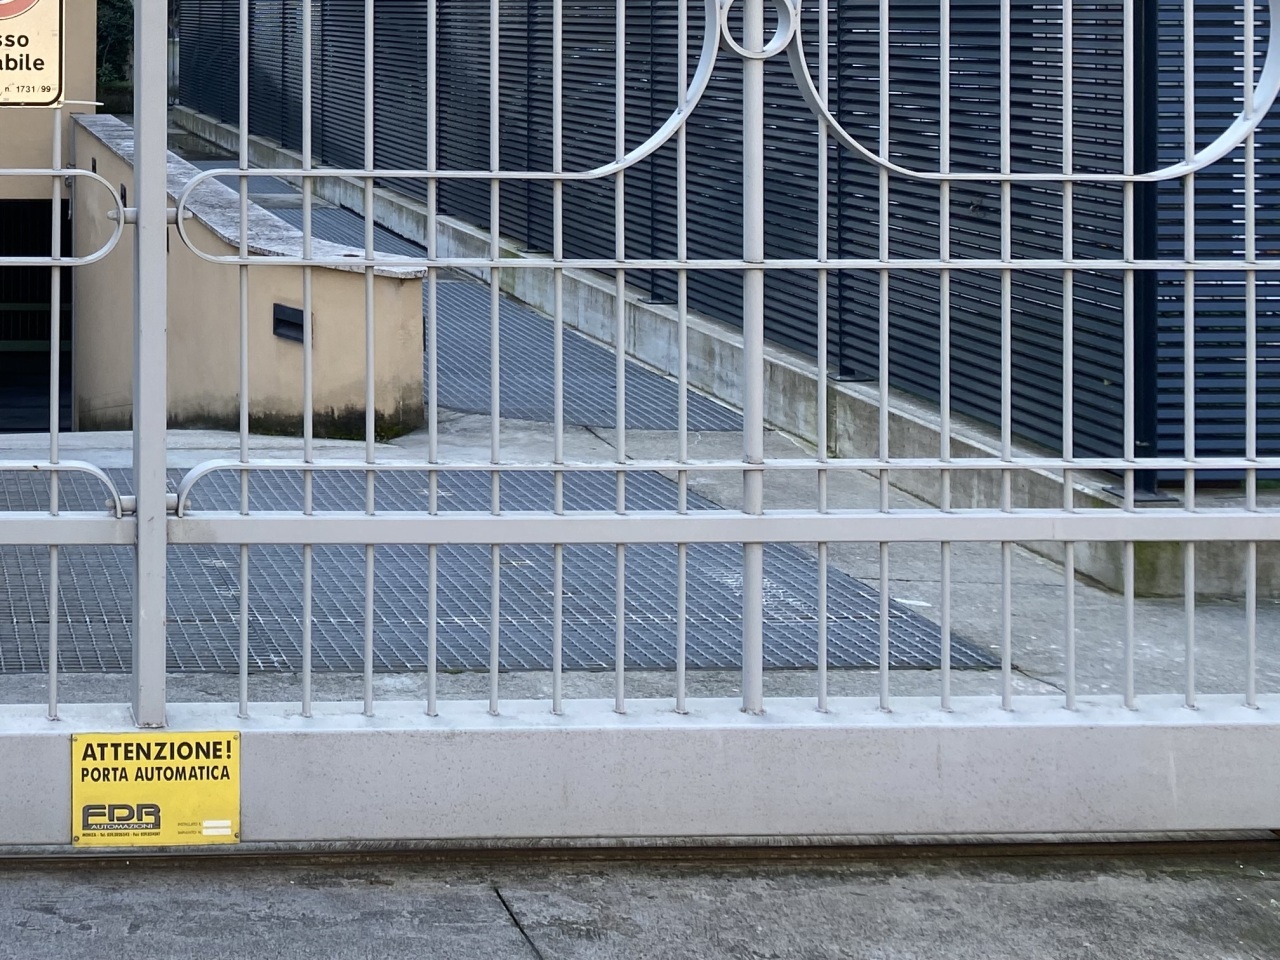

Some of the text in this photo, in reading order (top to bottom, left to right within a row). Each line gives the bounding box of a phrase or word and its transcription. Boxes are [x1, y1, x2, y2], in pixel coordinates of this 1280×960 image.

[81, 740, 232, 761] ATTENZIONE!
[81, 765, 230, 782] PORTA AUTOMATICA
[82, 804, 161, 830] FDR
